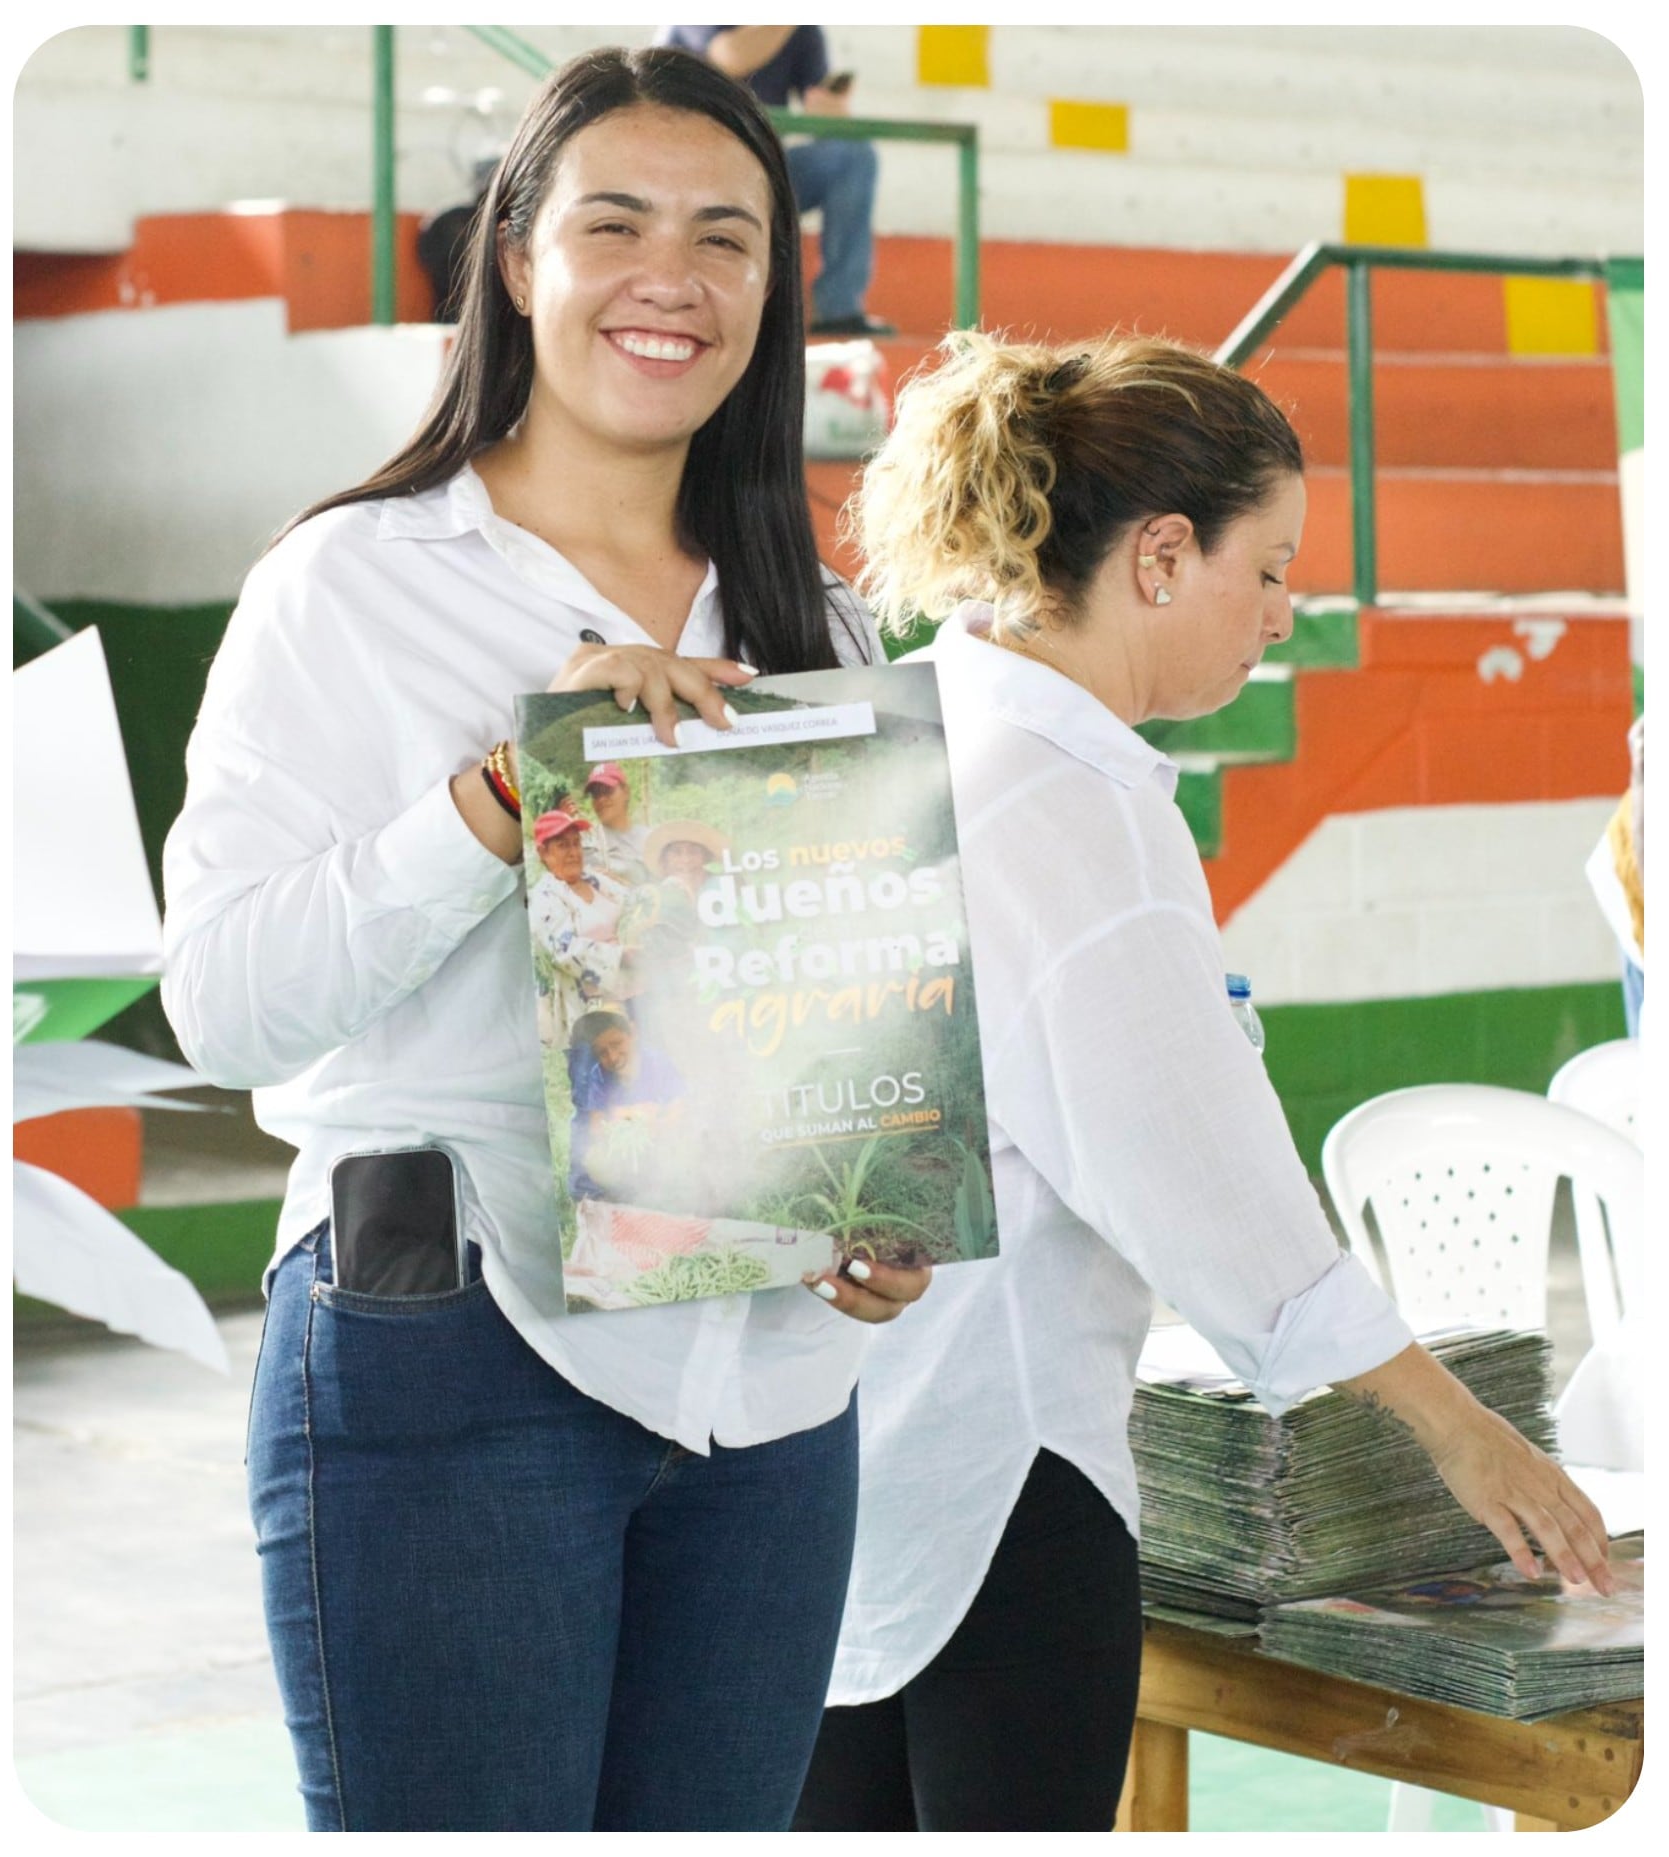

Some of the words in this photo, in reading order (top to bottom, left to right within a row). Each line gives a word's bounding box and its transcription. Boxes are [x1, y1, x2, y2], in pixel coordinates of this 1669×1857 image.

[722, 848, 781, 874] Los
[789, 835, 908, 867] nuevos
[696, 860, 943, 929] dueños
[693, 930, 960, 991] Reforma
[707, 965, 956, 1057] agraria
[760, 1127, 794, 1145] QUE
[797, 1118, 854, 1138] SUMAN
[857, 1116, 878, 1132] AL
[879, 1108, 942, 1128] CAMBIO
